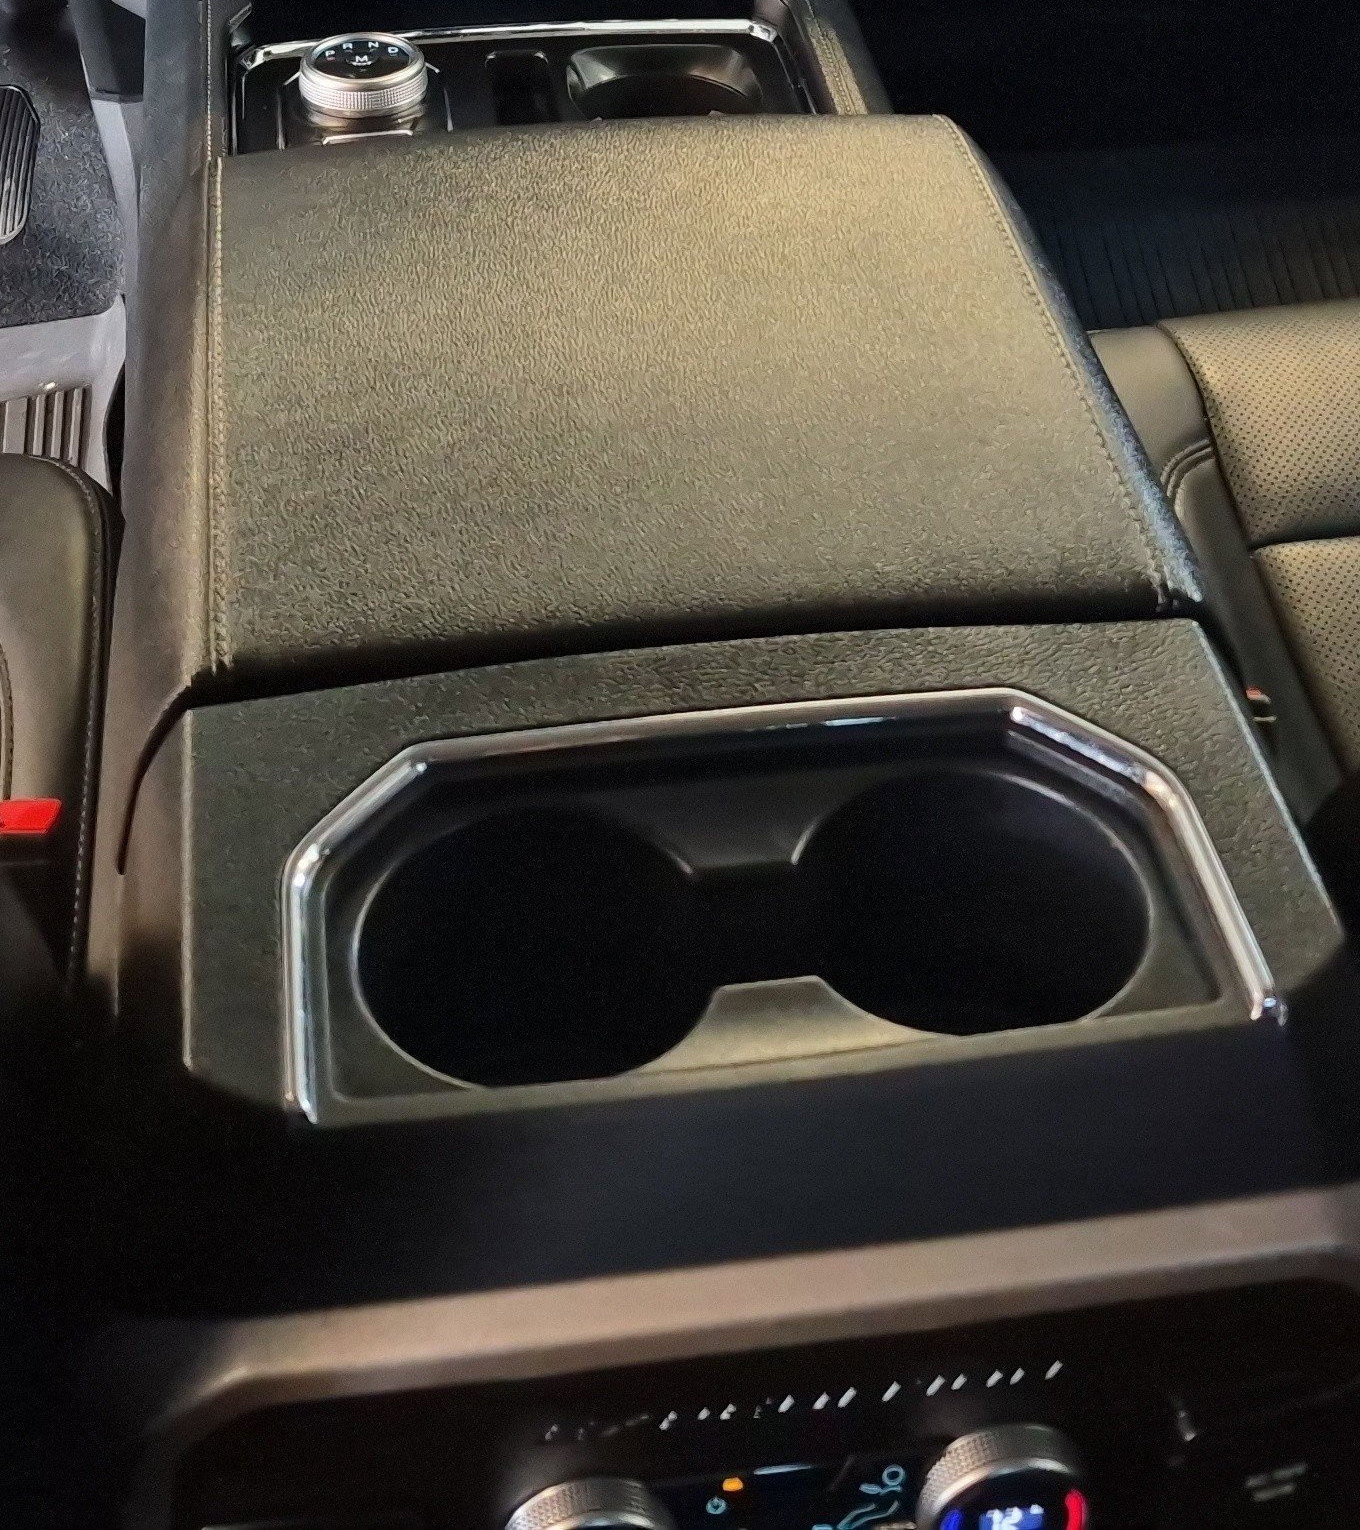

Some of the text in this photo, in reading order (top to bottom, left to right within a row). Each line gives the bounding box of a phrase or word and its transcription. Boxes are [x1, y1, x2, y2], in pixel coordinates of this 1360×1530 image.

[342, 42, 353, 50] R
[368, 41, 379, 49] N
[387, 46, 399, 54] D
[355, 55, 368, 63] M
